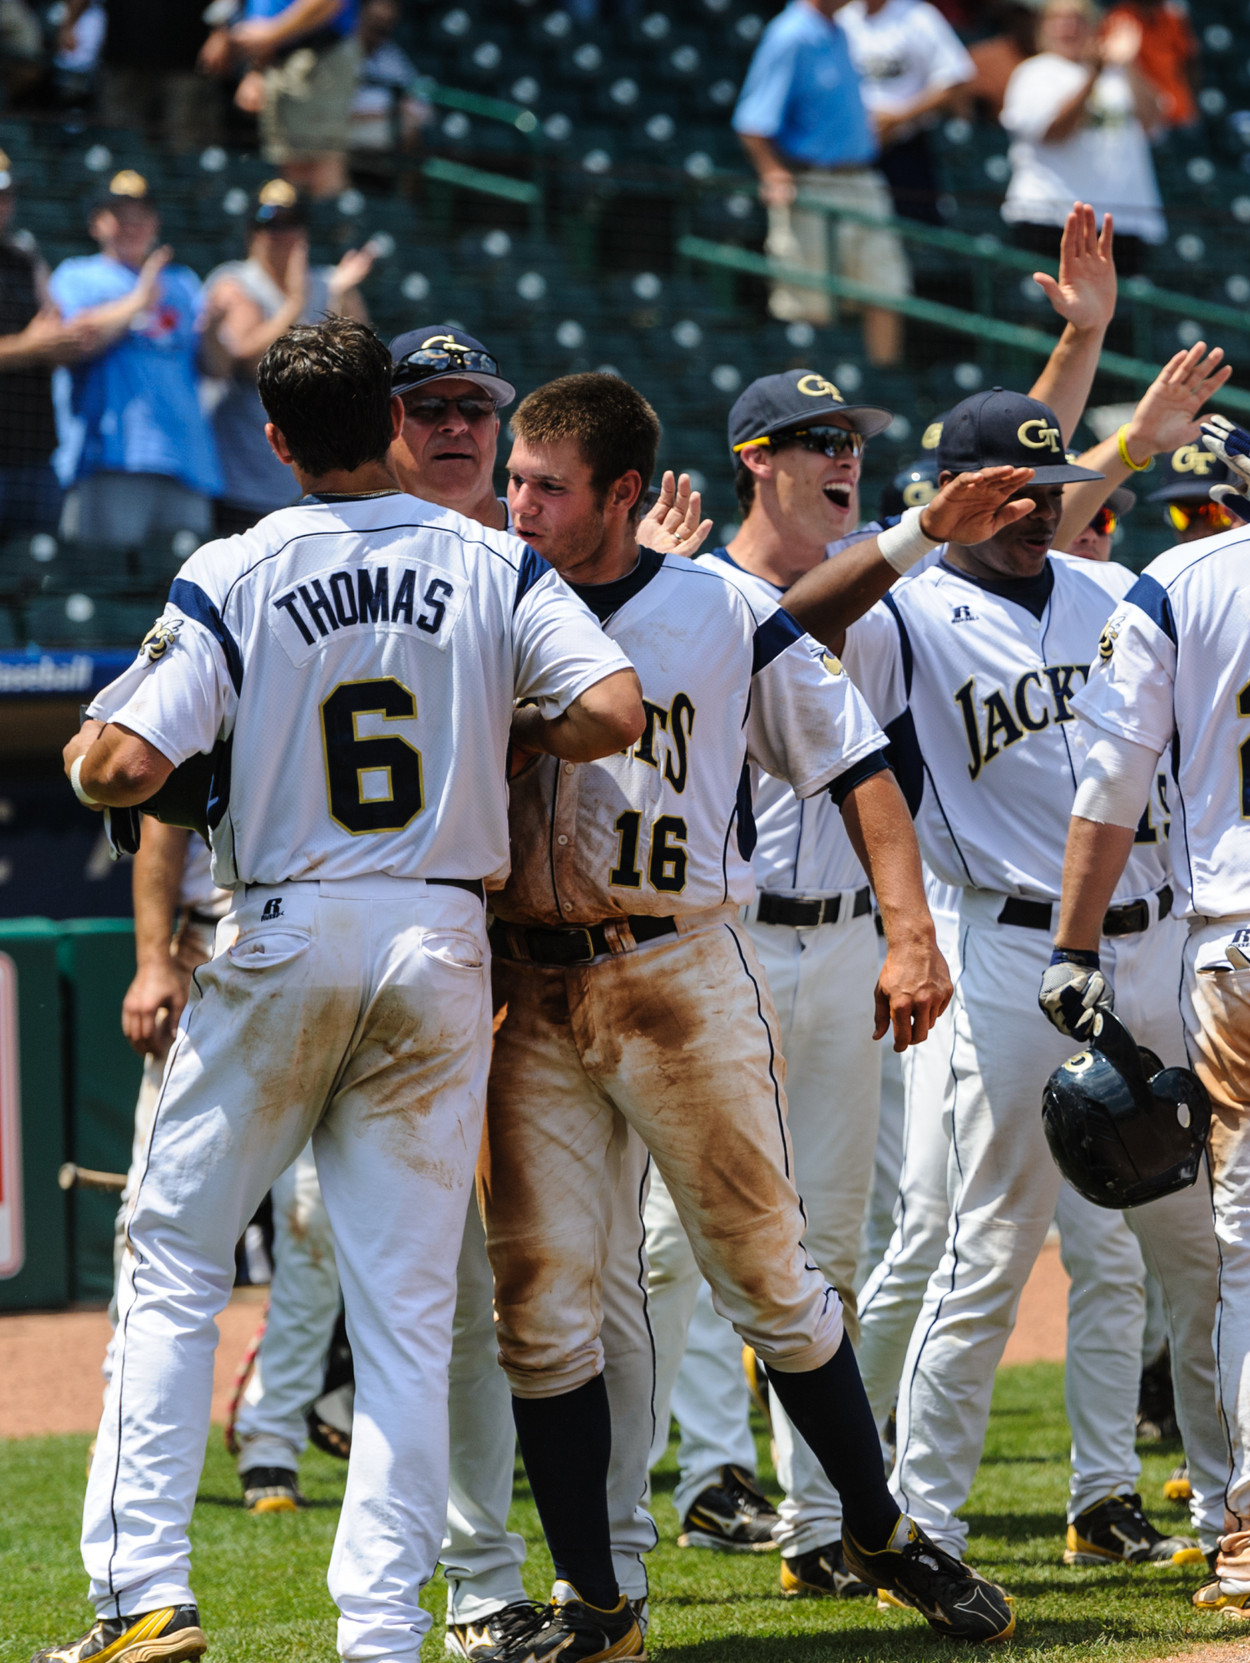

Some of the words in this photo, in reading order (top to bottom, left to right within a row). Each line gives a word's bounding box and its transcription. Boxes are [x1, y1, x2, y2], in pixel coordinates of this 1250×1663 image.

[797, 374, 845, 403] GT
[1017, 418, 1061, 452] GT
[1171, 444, 1217, 475] GT
[273, 567, 454, 646] THOMAS
[318, 675, 425, 836] 6
[608, 809, 689, 894] 16
